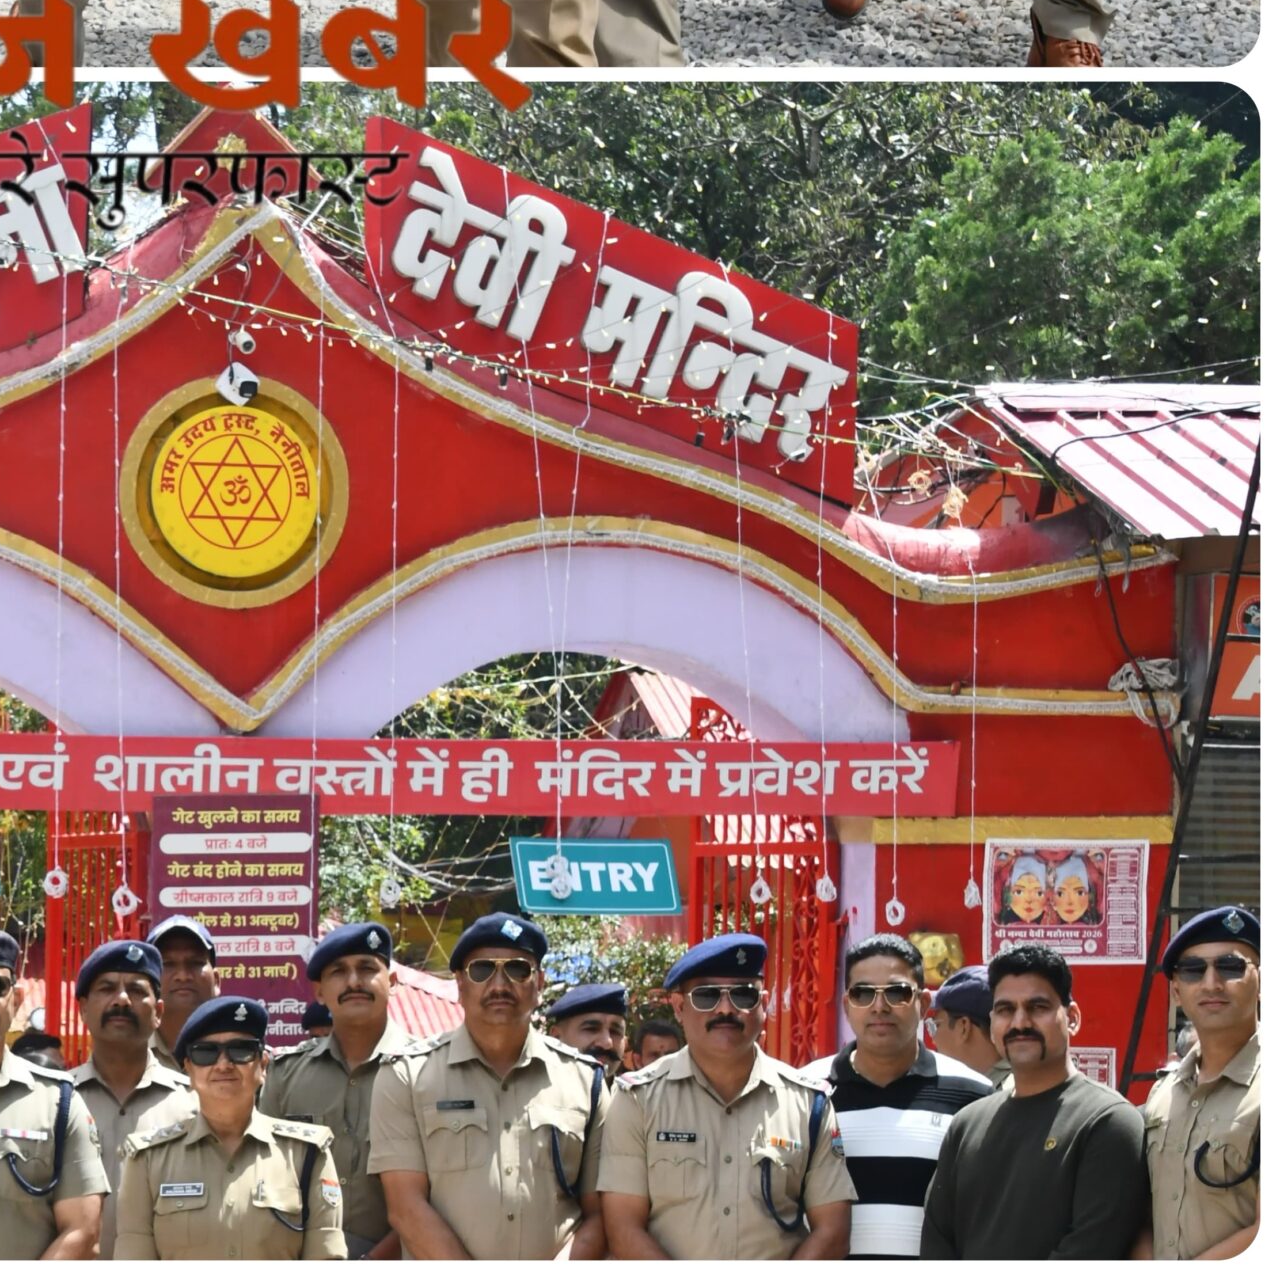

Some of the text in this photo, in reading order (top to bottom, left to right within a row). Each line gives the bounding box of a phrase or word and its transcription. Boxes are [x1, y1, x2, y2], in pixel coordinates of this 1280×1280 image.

[392, 146, 849, 463] देवी मन्दिर
[160, 446, 184, 494] अमर
[177, 416, 217, 448] उदय
[269, 422, 311, 500] नैनीताल
[93, 743, 264, 794] शालीन
[273, 746, 398, 797] वस्त्रों
[406, 747, 451, 797] में
[458, 748, 514, 803] ही
[534, 748, 656, 800] मंदिर
[665, 748, 707, 797] में
[715, 748, 840, 797] प्रवेश
[849, 746, 930, 795] करें
[172, 807, 301, 829] गेट खुलने का समय
[235, 838, 243, 850] 4
[167, 860, 305, 879] गेट बंद होने का समय
[173, 888, 234, 904] ग्रीष्मकाल
[238, 886, 263, 904] रात्रि
[220, 912, 232, 928] से
[234, 915, 248, 928] 31
[1081, 929, 1103, 938] 2026
[234, 937, 261, 953] रात्रि
[264, 942, 272, 953] 8
[234, 962, 246, 978] से
[248, 966, 261, 978] 31
